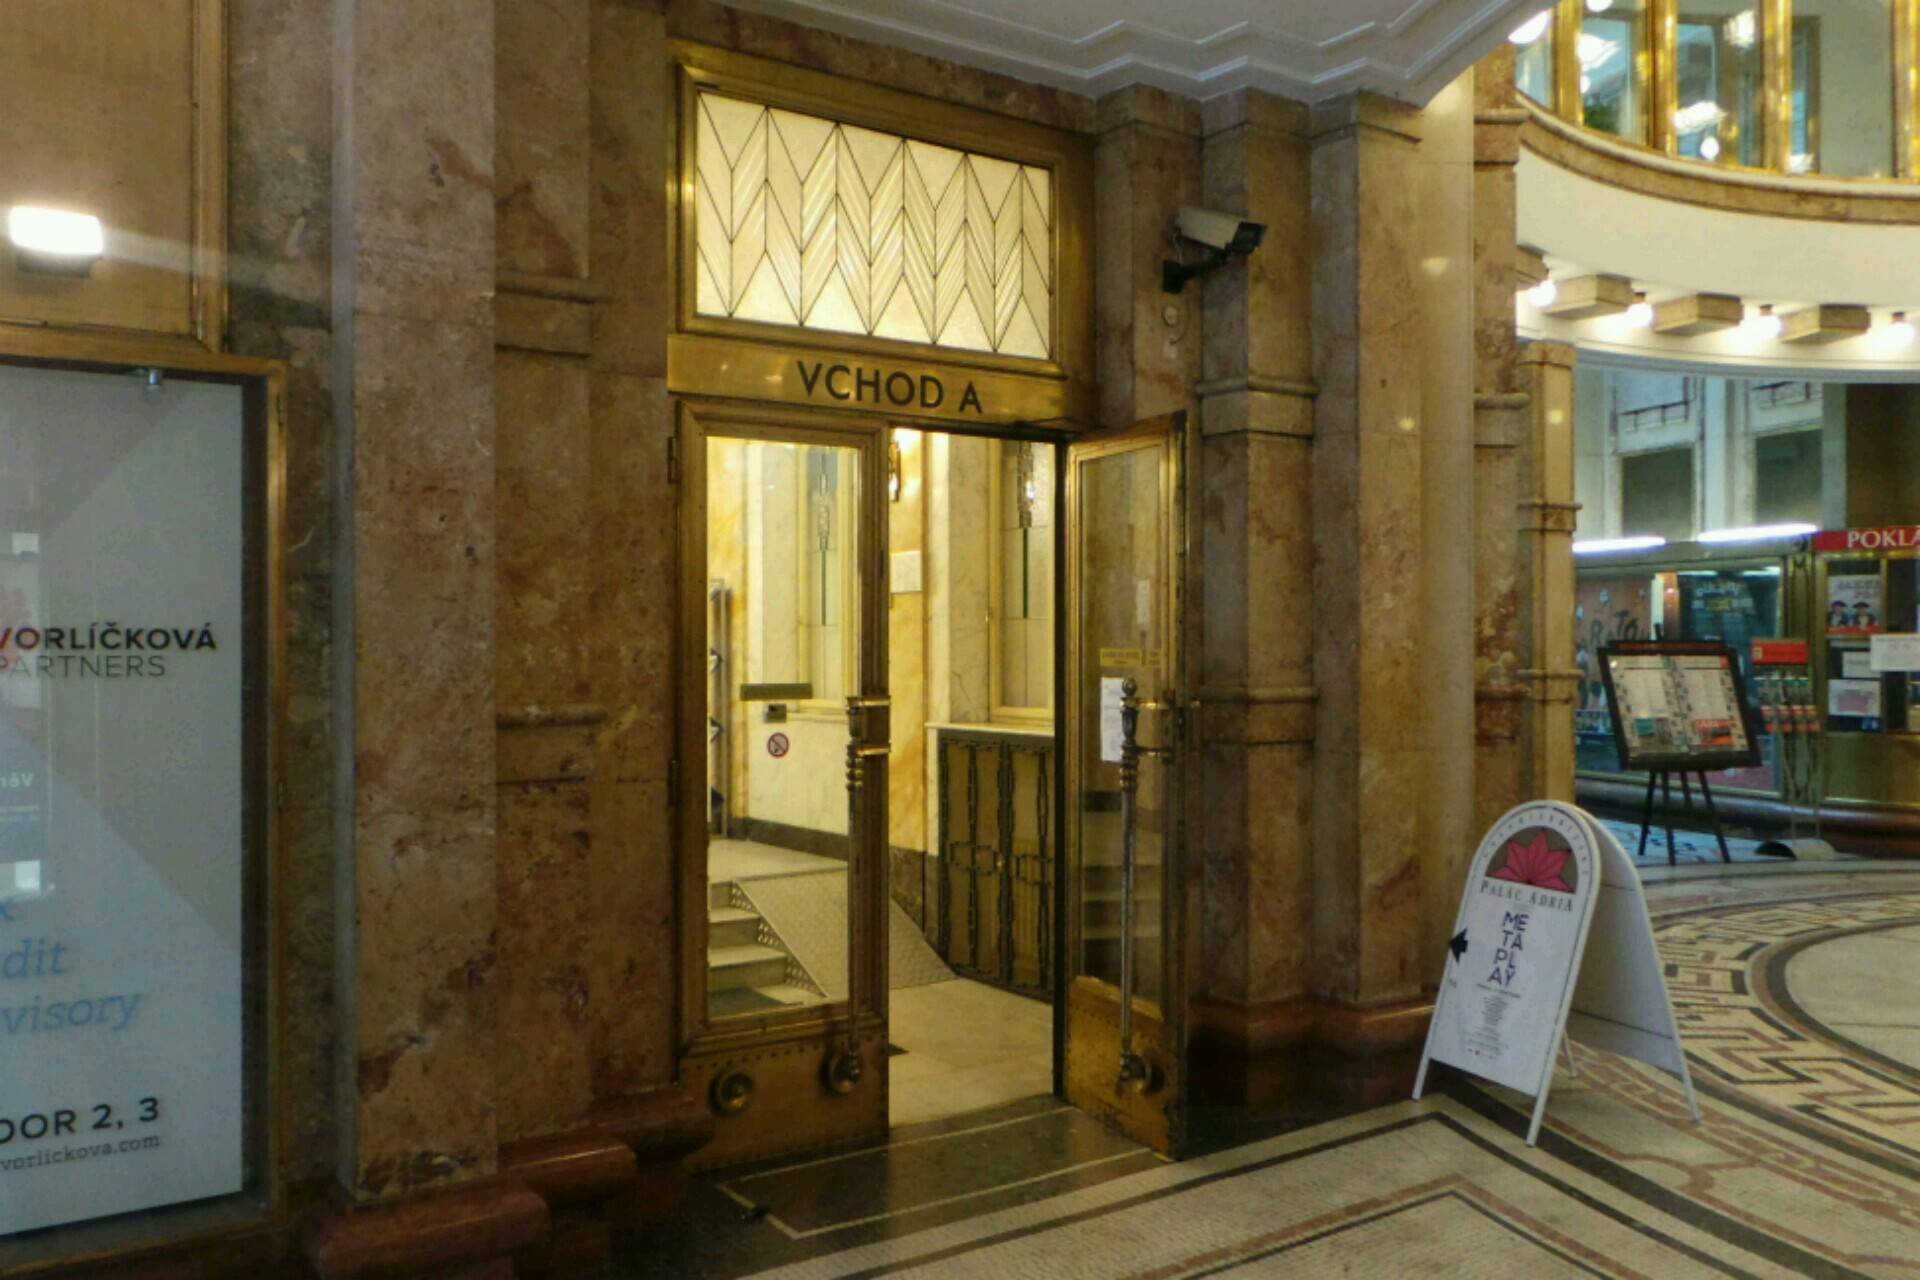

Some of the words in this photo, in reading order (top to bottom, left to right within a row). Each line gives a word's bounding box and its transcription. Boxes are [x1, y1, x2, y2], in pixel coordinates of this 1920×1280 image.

[797, 360, 944, 408] VCHOD
[958, 380, 983, 414] A
[92, 1103, 124, 1130] 2,
[139, 1097, 159, 1122] 3
